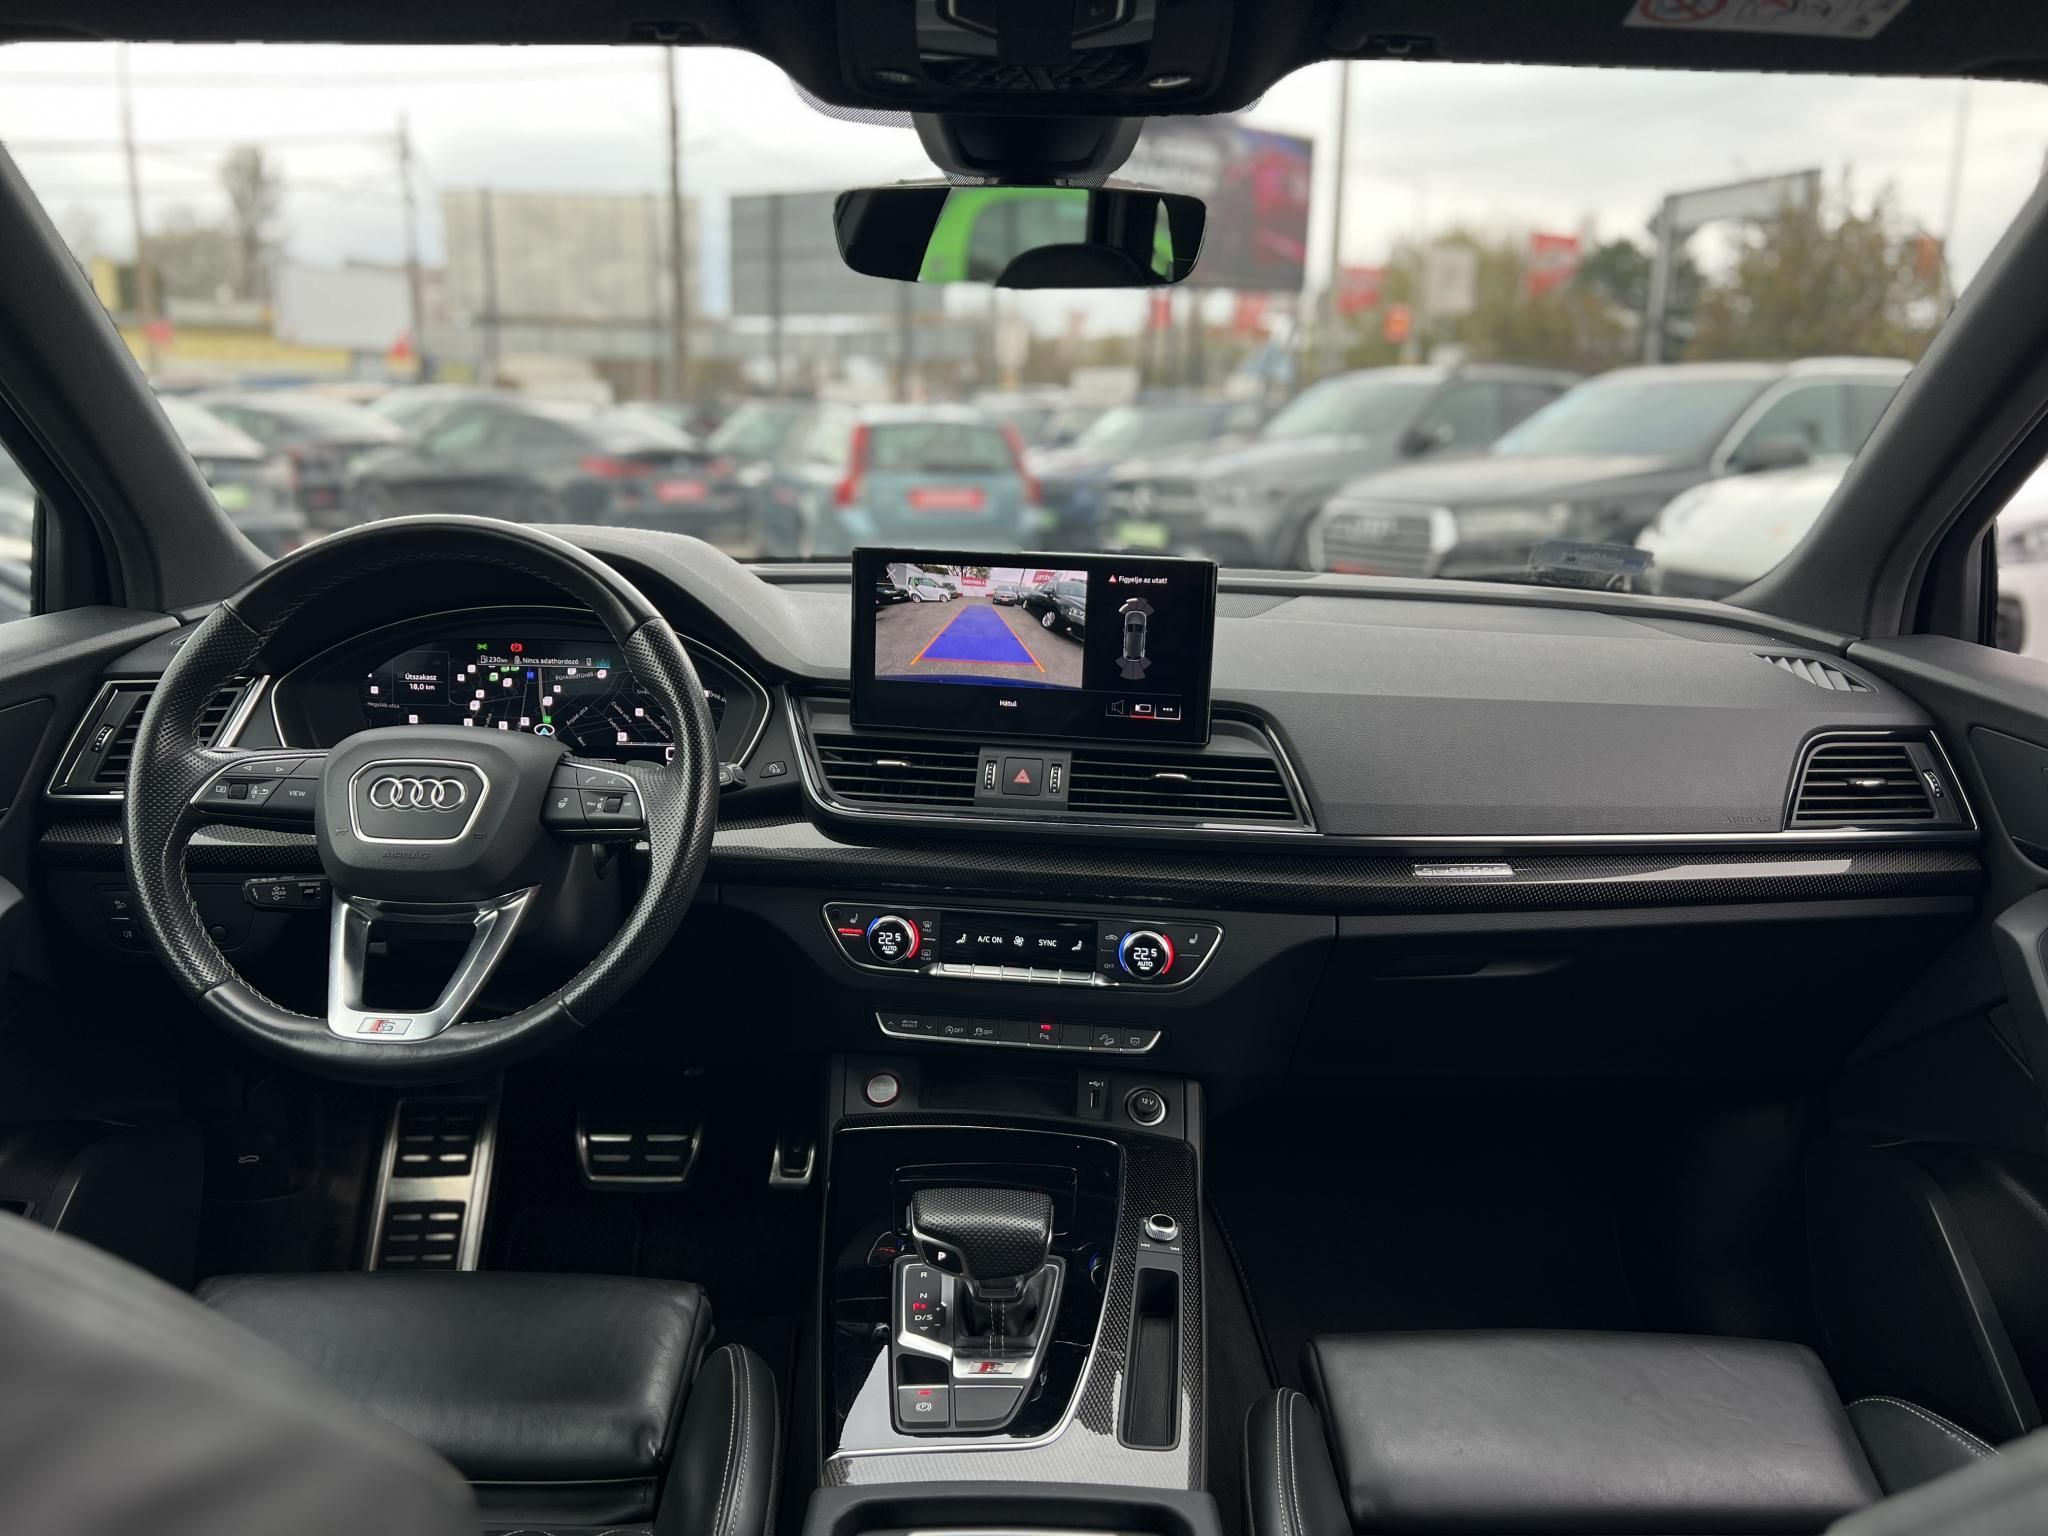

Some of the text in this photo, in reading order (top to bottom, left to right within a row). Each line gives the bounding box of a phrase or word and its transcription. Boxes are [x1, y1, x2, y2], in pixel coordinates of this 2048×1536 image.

[1118, 576, 1142, 584] Figyelje
[1038, 939, 1057, 947] SYNC
[938, 1252, 946, 1260] P
